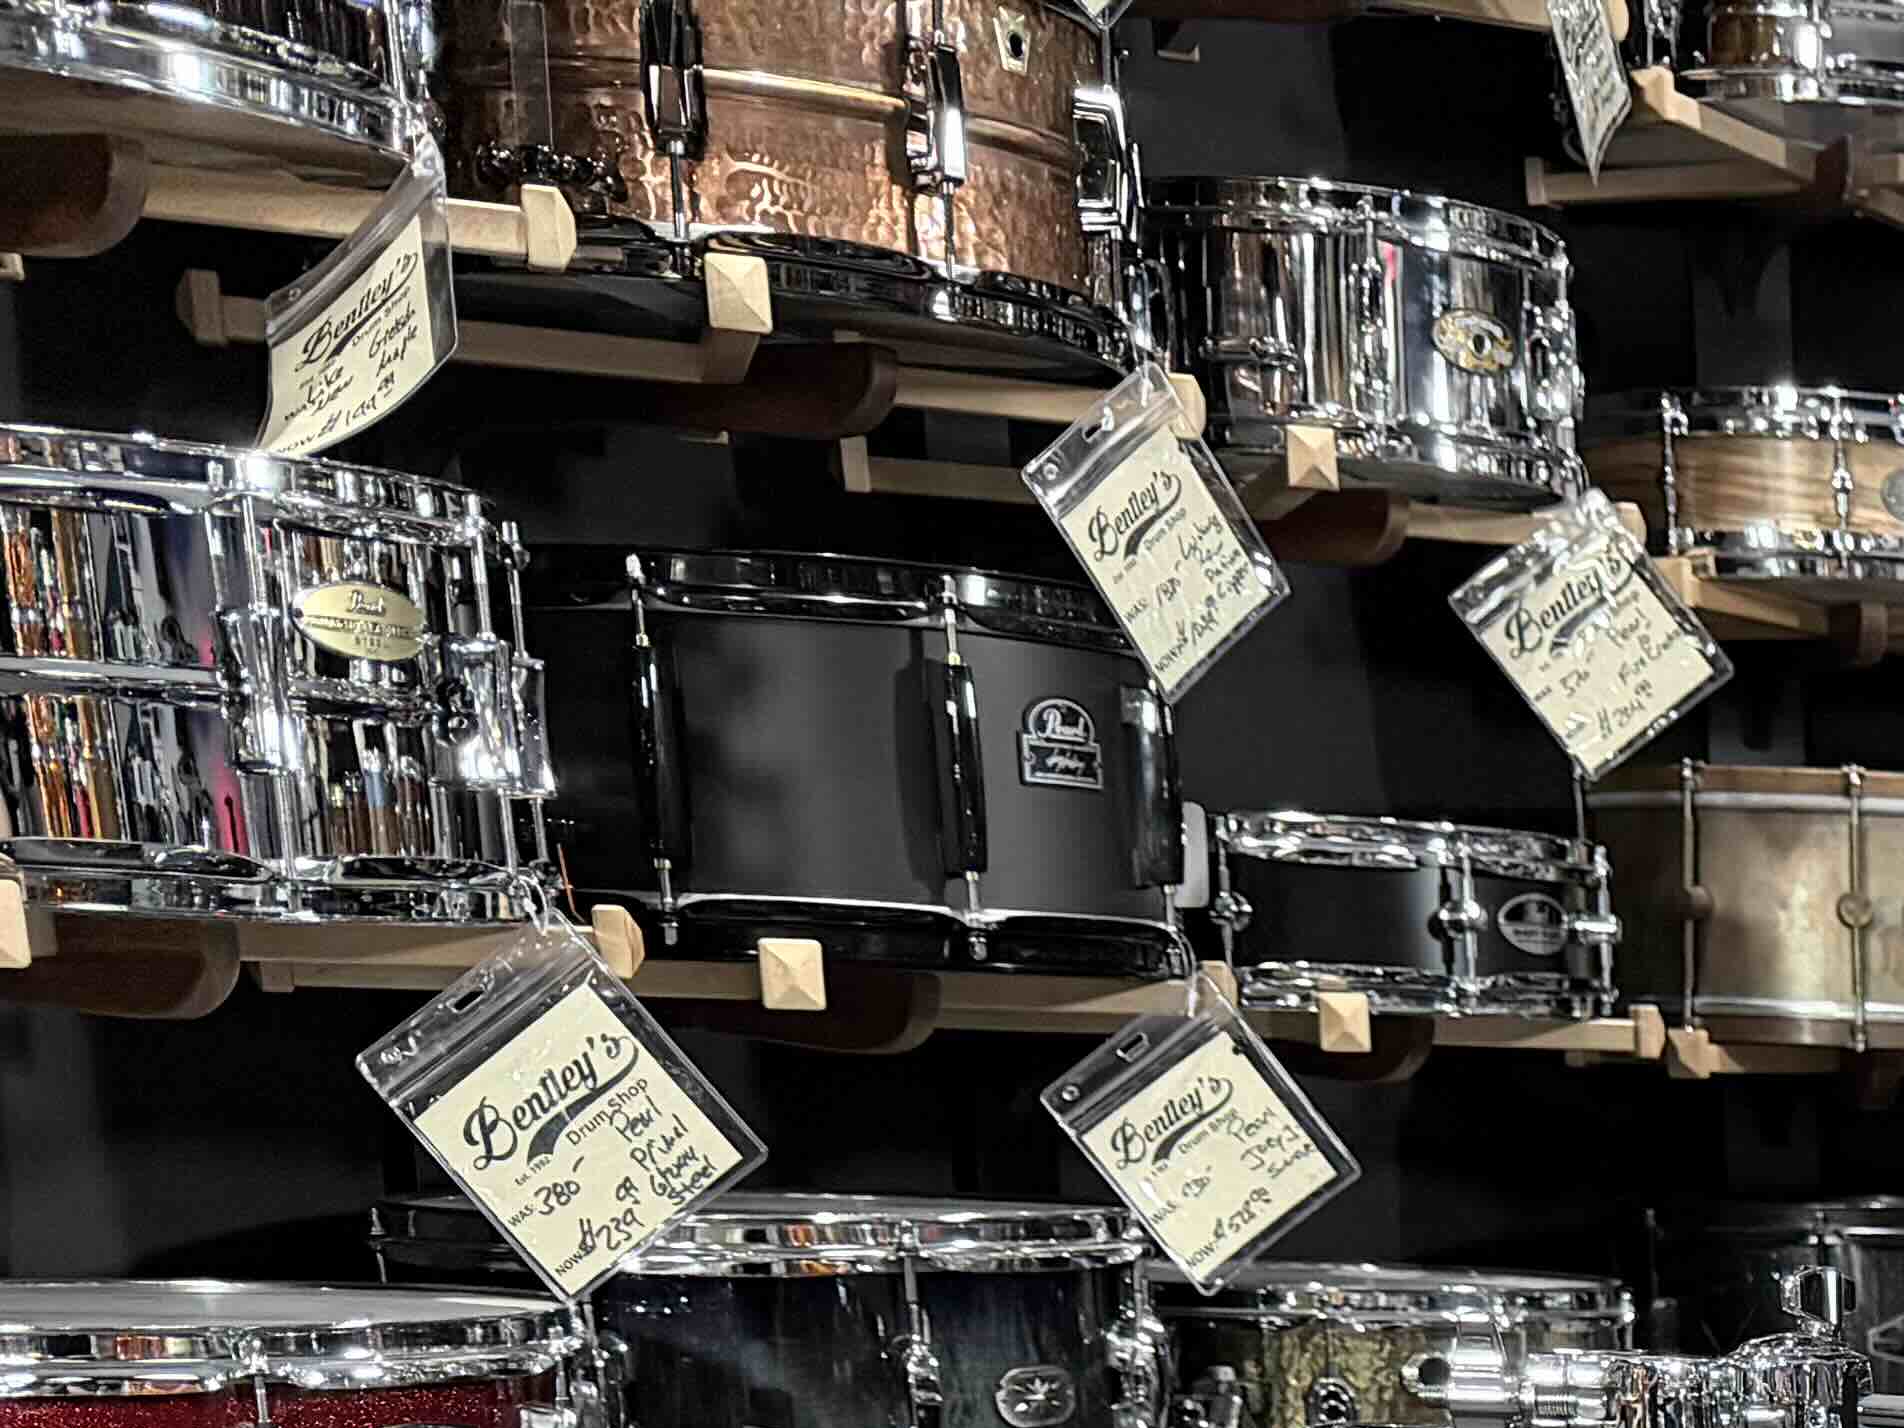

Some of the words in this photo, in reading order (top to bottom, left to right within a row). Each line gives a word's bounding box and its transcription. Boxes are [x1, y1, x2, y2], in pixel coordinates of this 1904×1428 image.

[294, 253, 414, 372] Bentley's
[1088, 470, 1177, 562] Bentley's
[1038, 707, 1086, 743] Pearl
[463, 1032, 622, 1171] Bentley's
[566, 1108, 611, 1147] Drum
[608, 1077, 649, 1117] Shop
[1111, 1076, 1223, 1171] Bentley's
[1178, 1128, 1209, 1156] Drum
[508, 1205, 536, 1229] WAS:
[535, 1179, 581, 1216] 380
